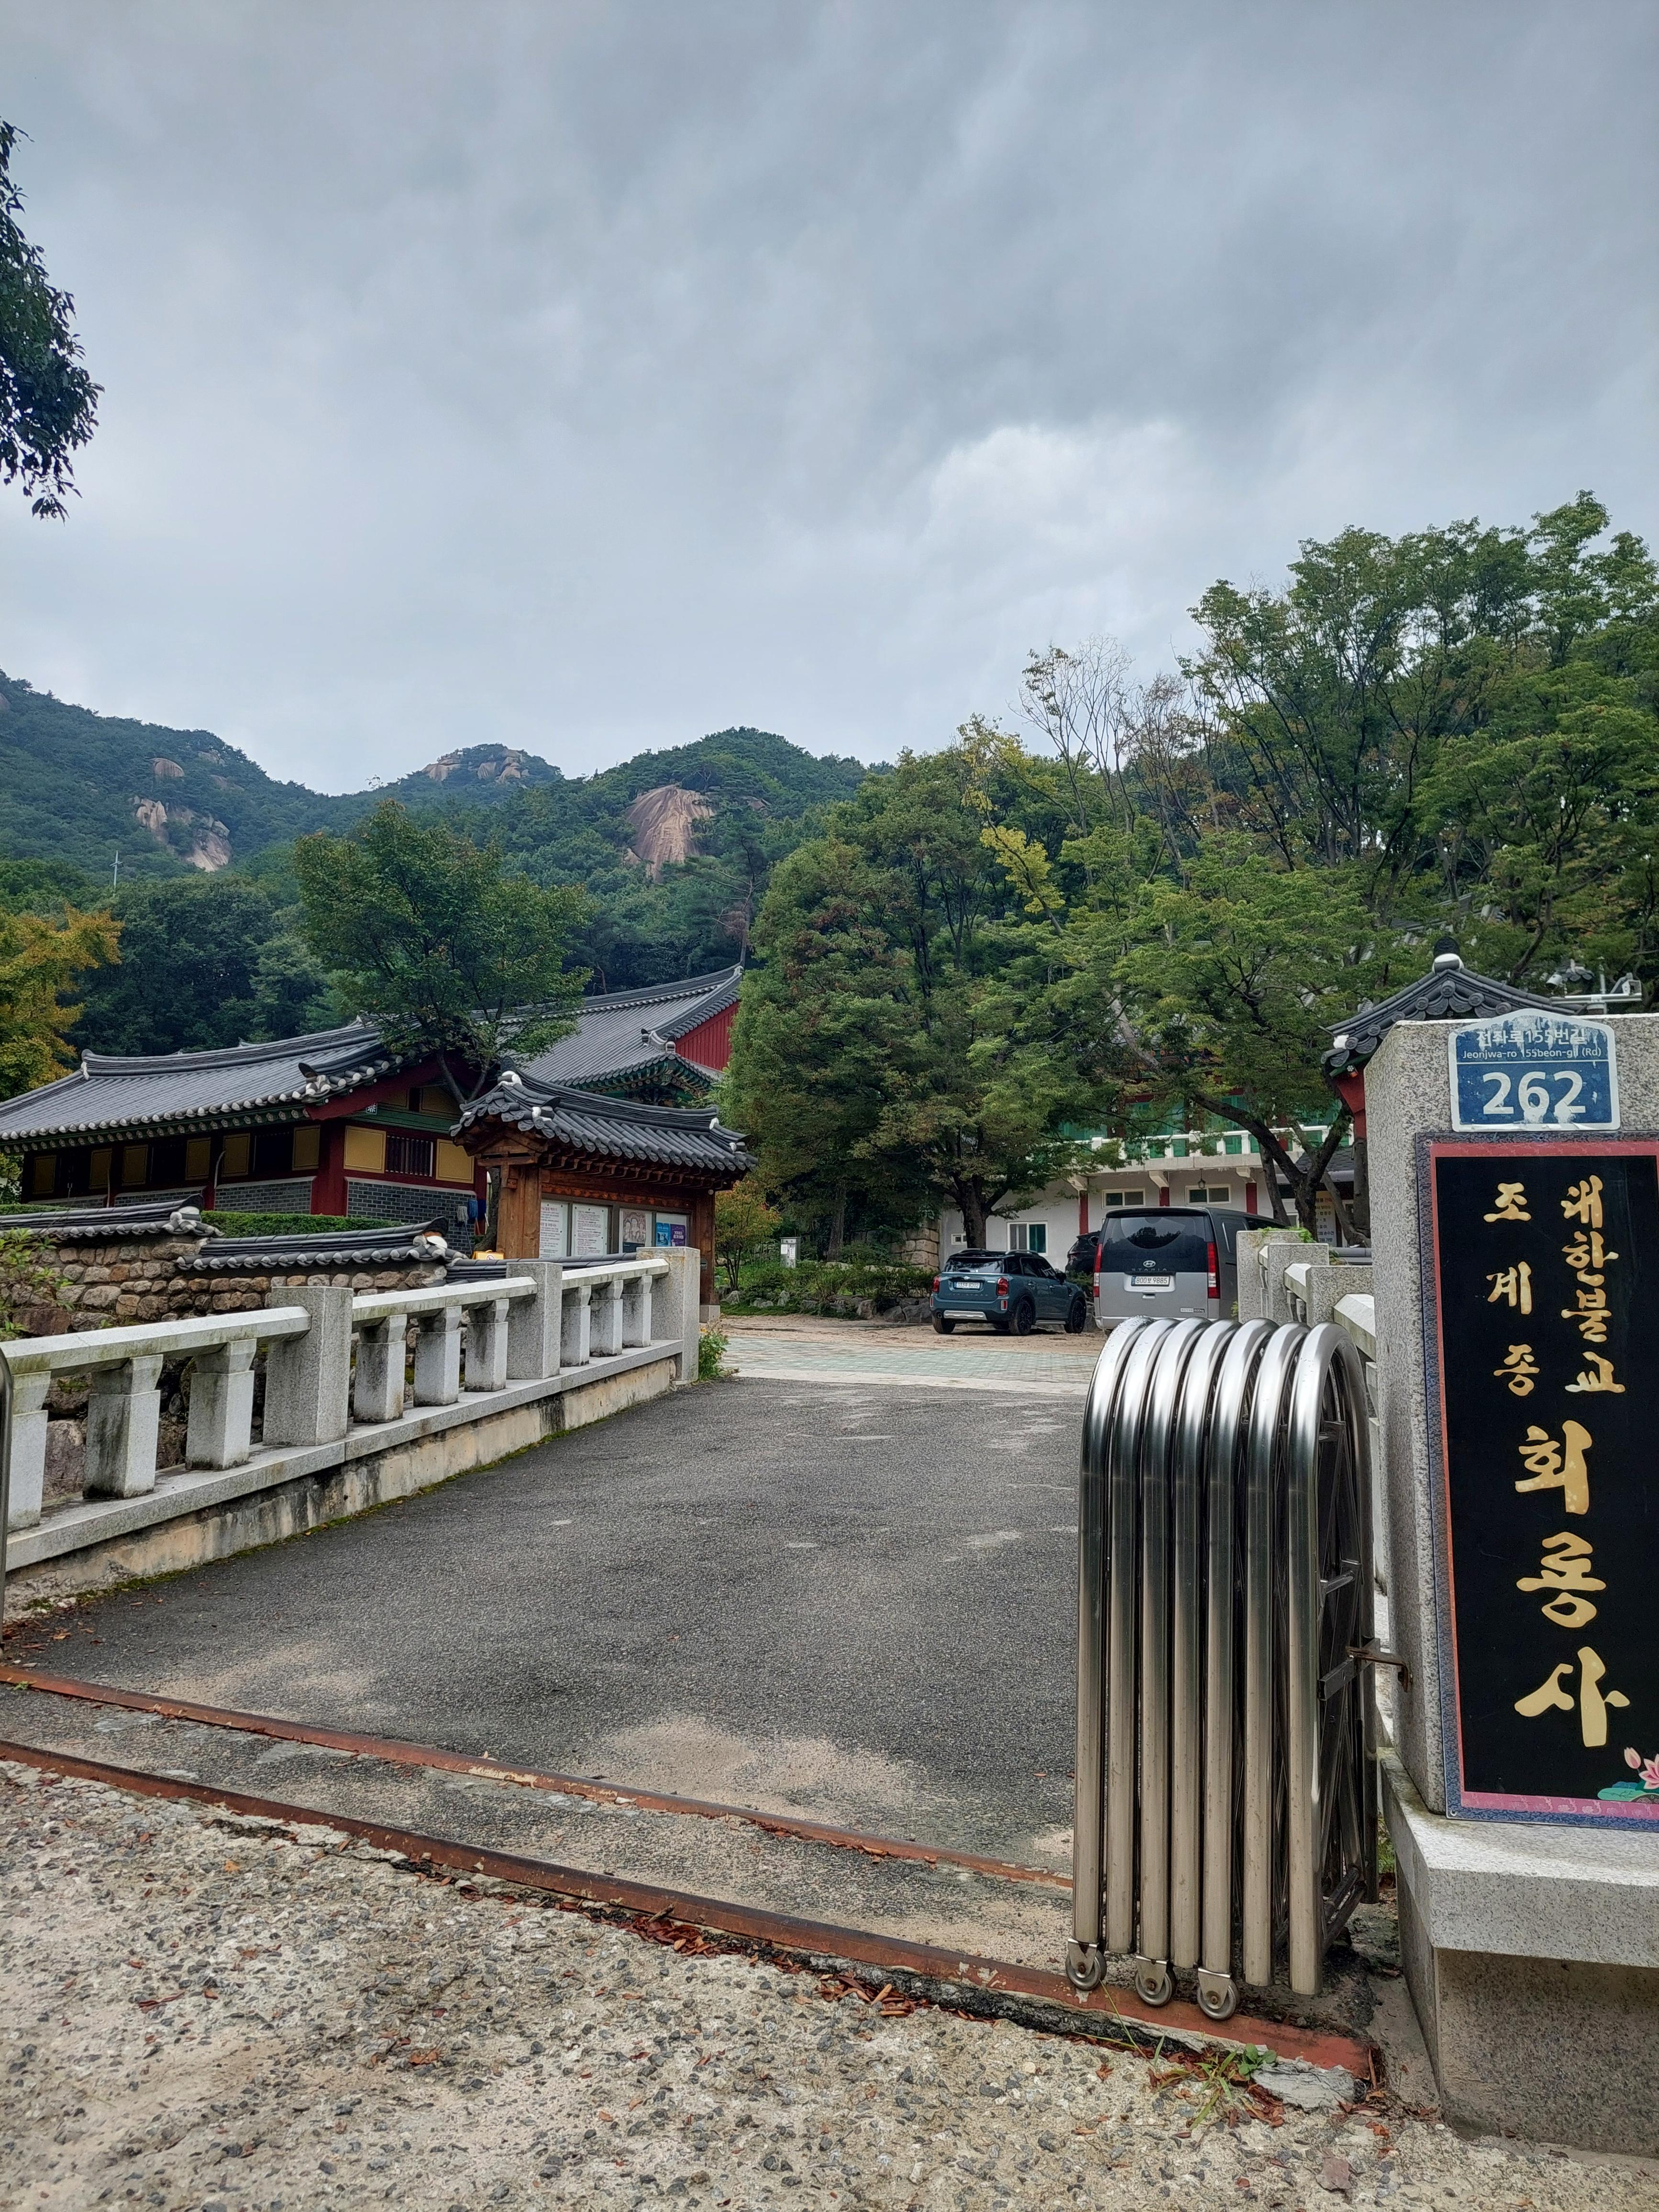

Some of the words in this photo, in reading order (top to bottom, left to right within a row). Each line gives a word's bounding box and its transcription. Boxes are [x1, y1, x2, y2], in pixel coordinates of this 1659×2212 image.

[1463, 1050, 1517, 1059] Jeonjwa-ro
[1582, 1048, 1601, 1057] (Rd)
[1483, 1070, 1586, 1115] 262
[1483, 1182, 1540, 1396] 조계종
[1560, 1175, 1626, 1393] 대한불교
[1514, 1420, 1630, 1747] 회룡사
